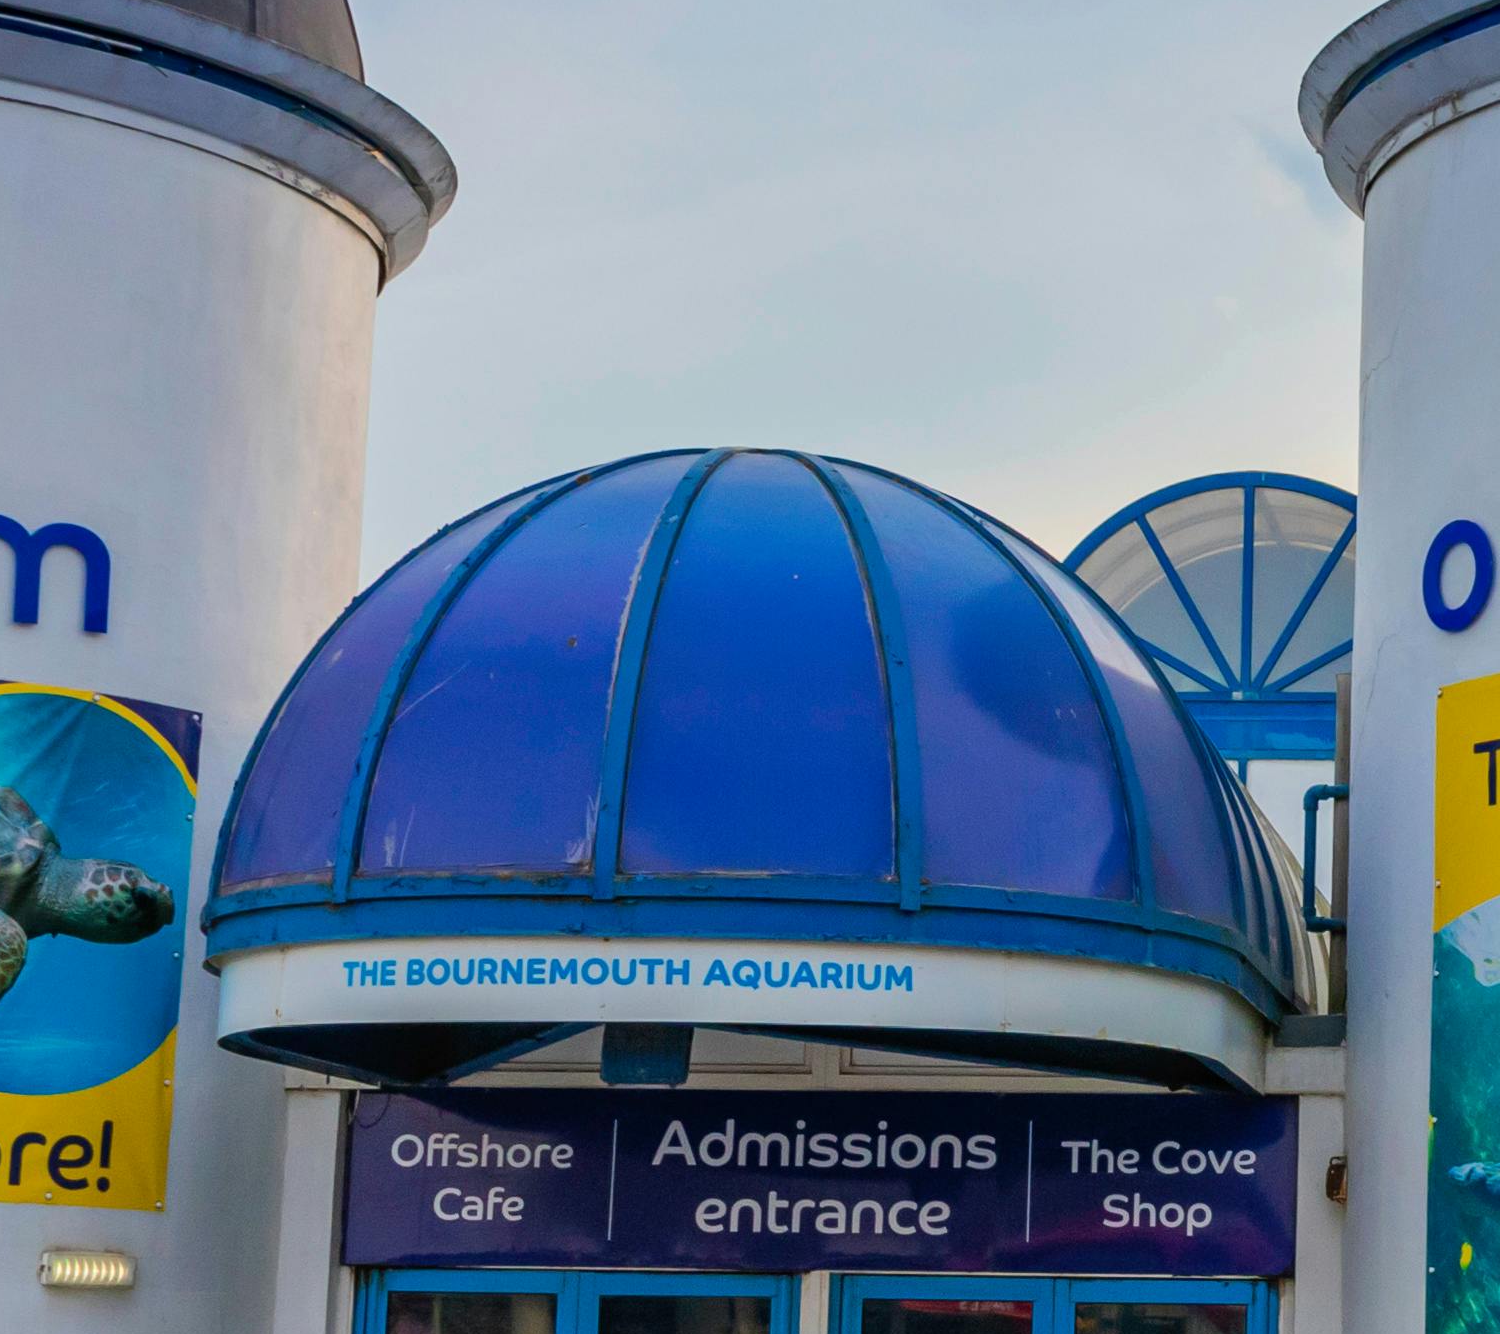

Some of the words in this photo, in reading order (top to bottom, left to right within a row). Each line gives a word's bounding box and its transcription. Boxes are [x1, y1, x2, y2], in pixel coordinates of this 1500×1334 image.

[342, 958, 399, 988] THE
[405, 956, 692, 987] BOURNEMOUTH
[702, 958, 915, 993] AQUARIUM
[390, 1133, 574, 1169] Offshore
[651, 1118, 997, 1169] Admissions
[1061, 1139, 1140, 1174] The
[1151, 1140, 1257, 1175] Cove
[432, 1186, 525, 1222] Cafe
[695, 1191, 951, 1236] entrance
[1102, 1193, 1213, 1237] Shop
